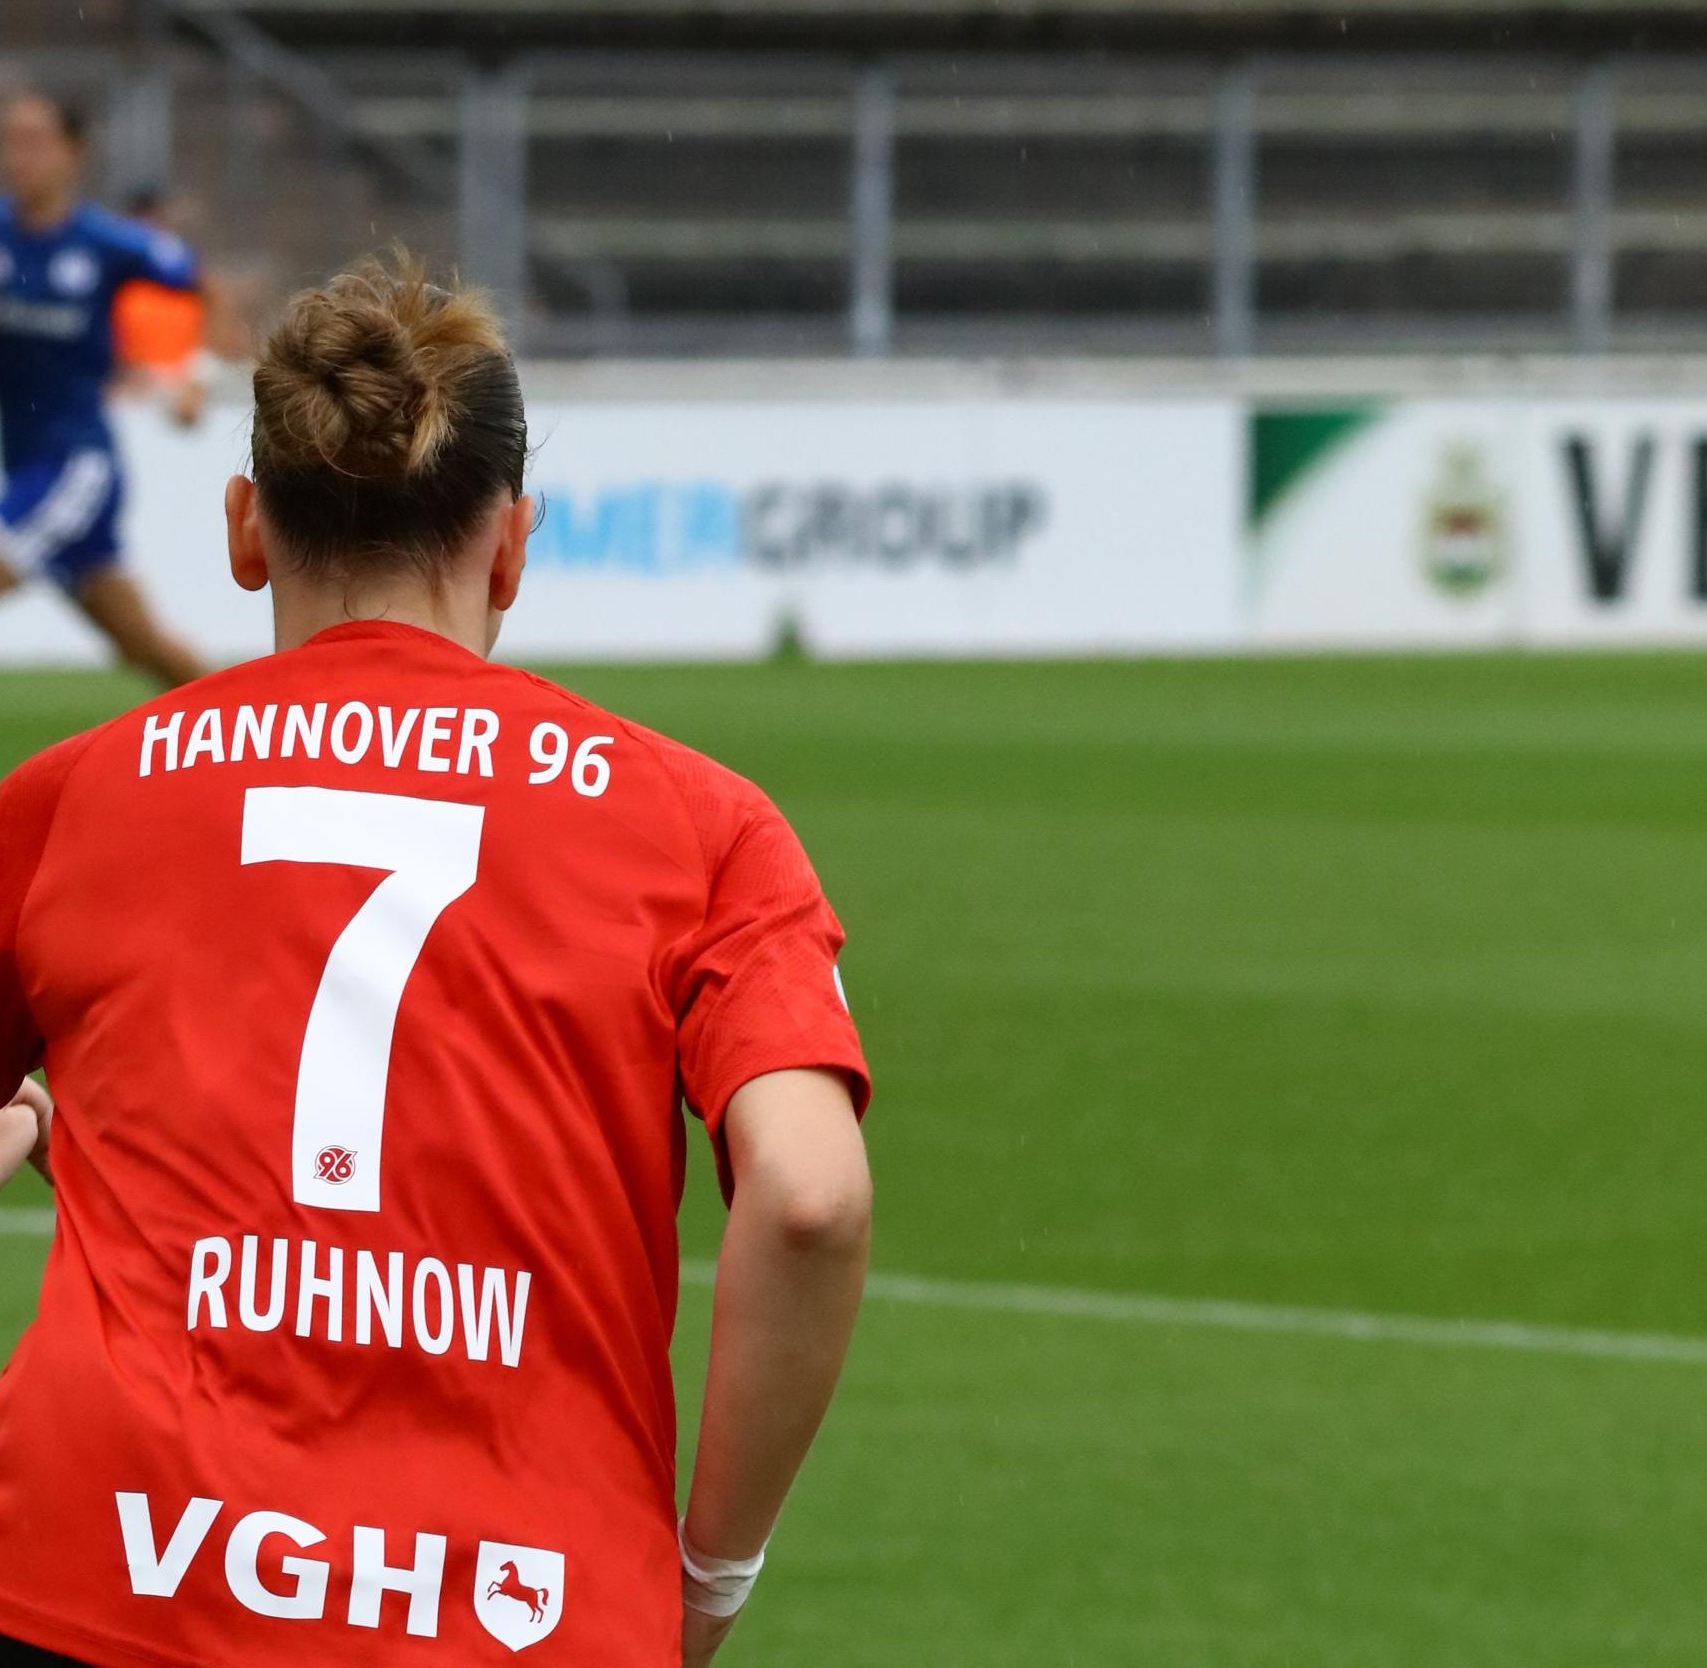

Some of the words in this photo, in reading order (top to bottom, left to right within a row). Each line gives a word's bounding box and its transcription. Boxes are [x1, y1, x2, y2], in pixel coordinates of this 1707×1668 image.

[532, 480, 1048, 576] MERGROUP
[140, 701, 499, 777] HANNOVER
[528, 722, 614, 797] 96
[241, 786, 485, 1212] 7
[316, 1147, 356, 1182] 96
[187, 1235, 532, 1368] RUHNOW
[115, 1491, 447, 1638] VGH
